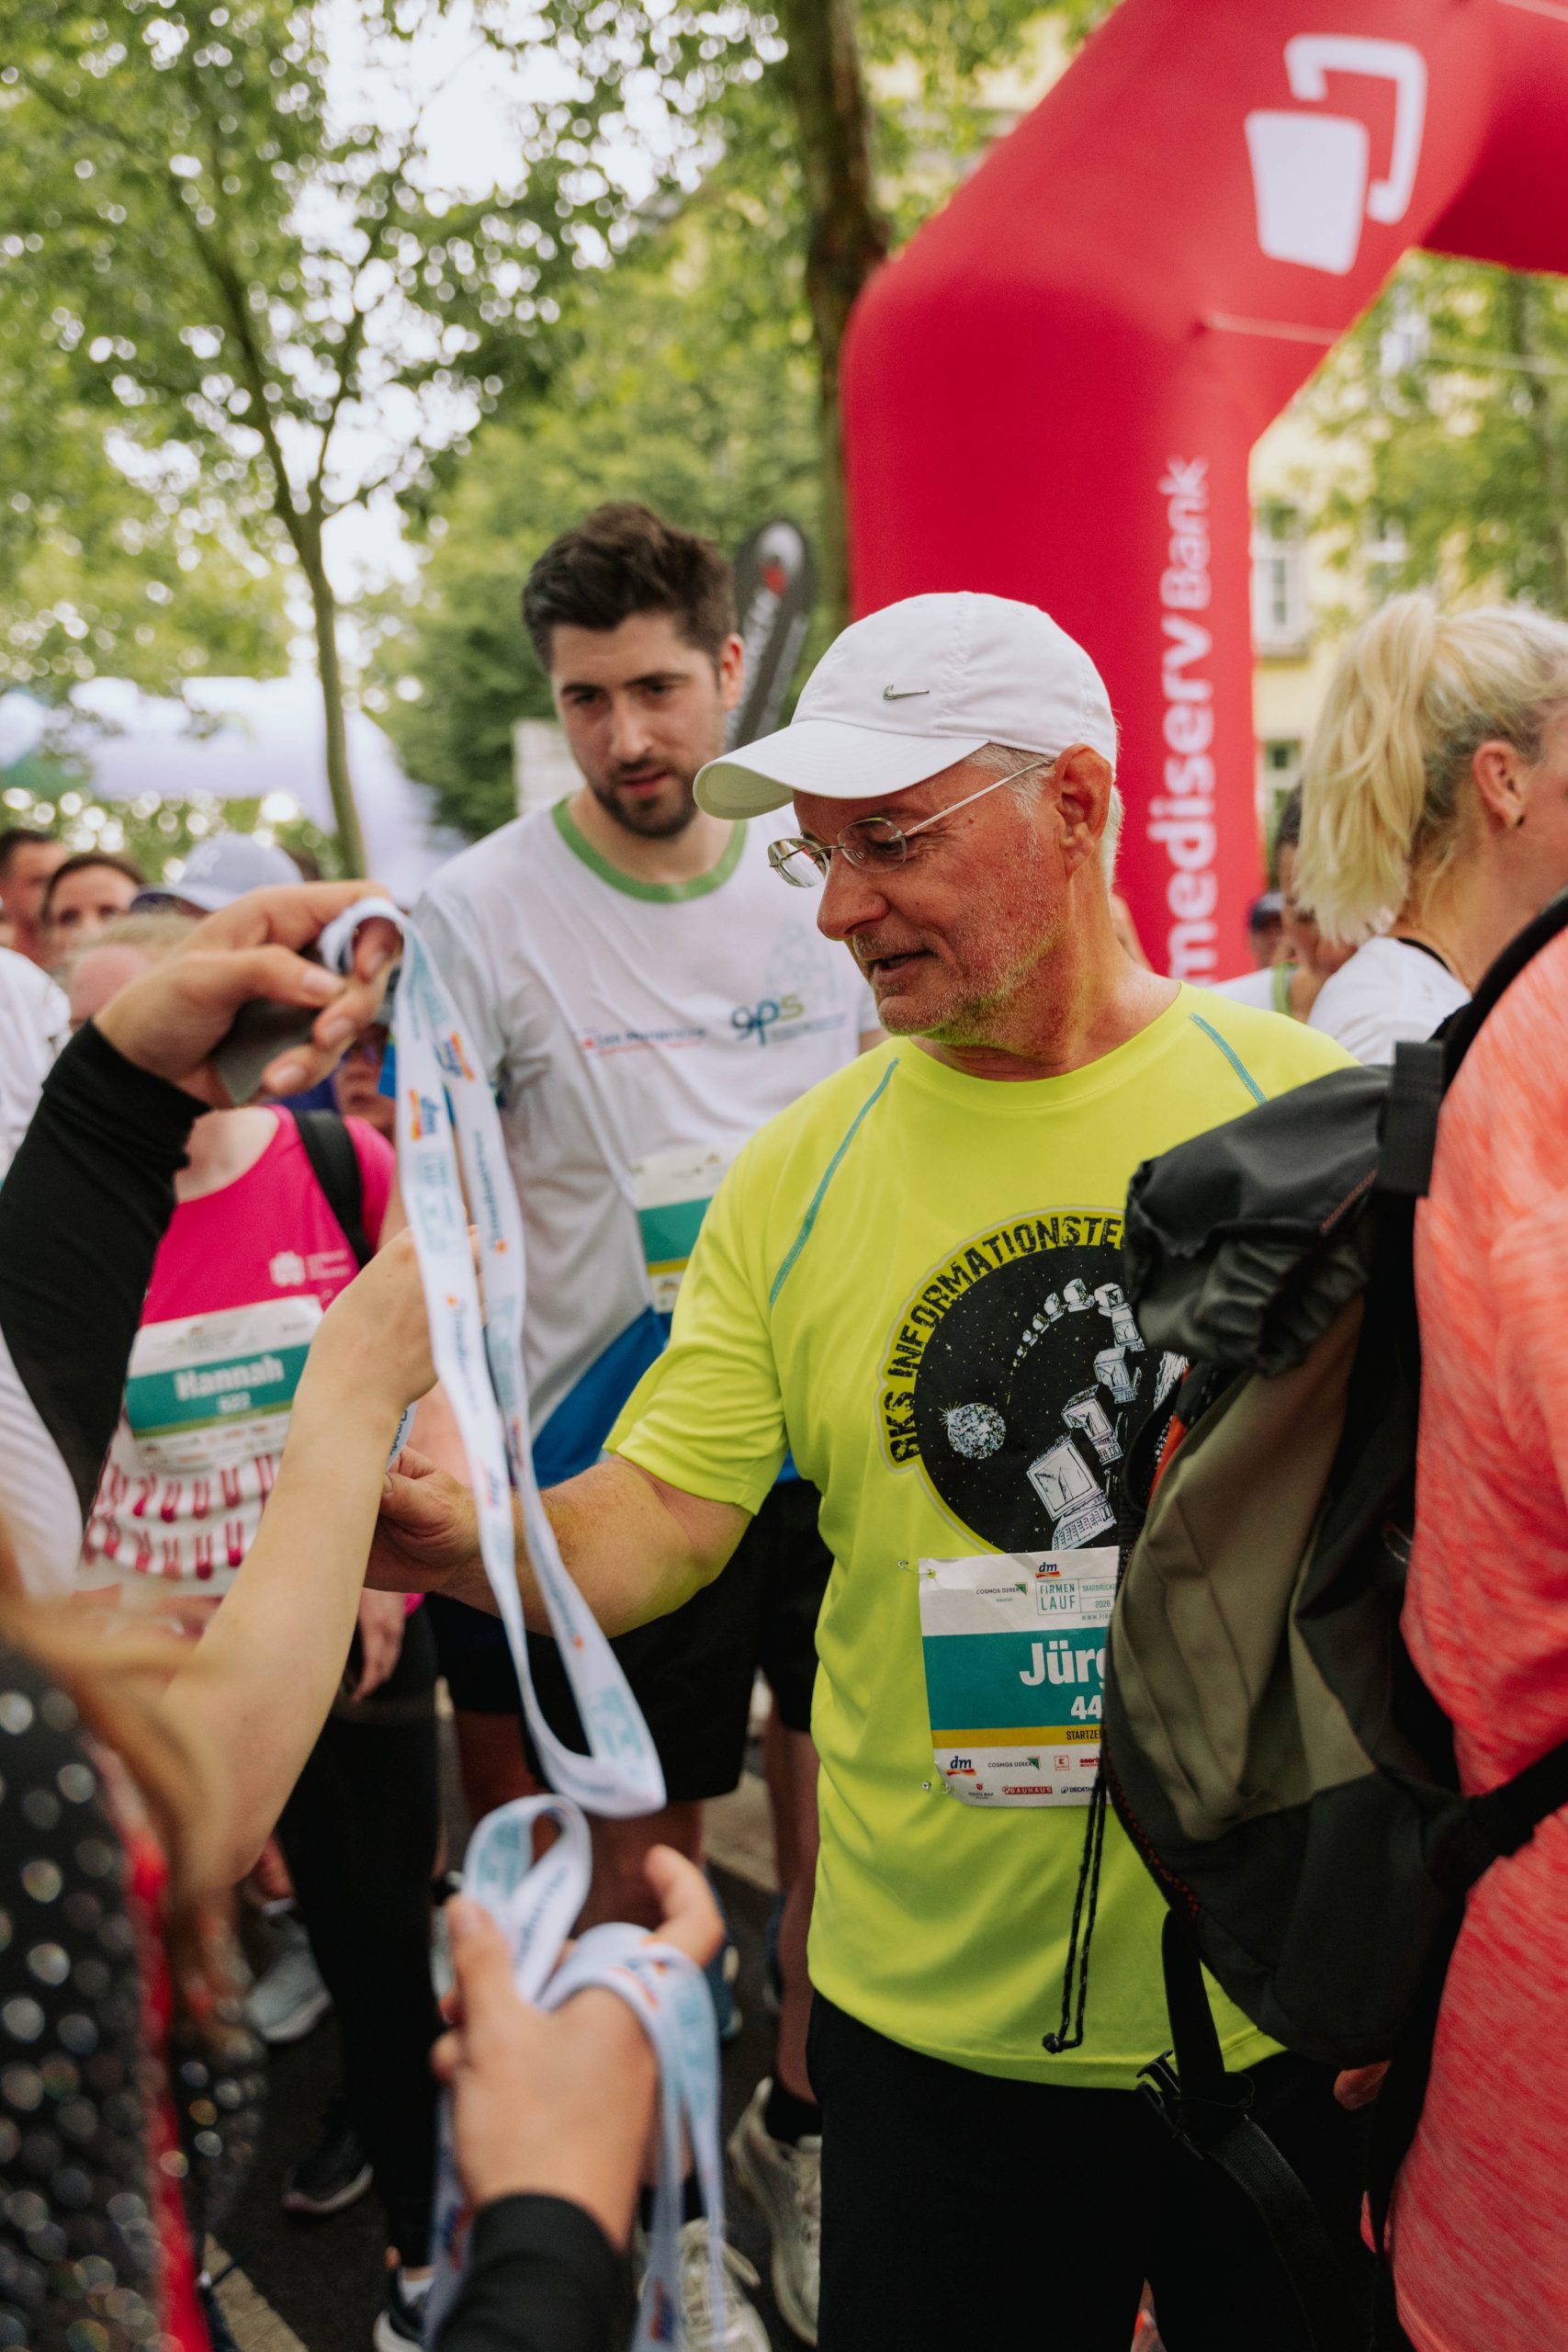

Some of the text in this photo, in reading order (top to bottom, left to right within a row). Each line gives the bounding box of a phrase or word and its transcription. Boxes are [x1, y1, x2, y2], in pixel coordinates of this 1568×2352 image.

[1148, 458, 1218, 987] mediserv Bank
[174, 1355, 285, 1401] Hannah
[1039, 1562, 1057, 1573] dm
[1040, 1583, 1075, 1594] FIRMEN
[1041, 1595, 1076, 1611] LAUF
[950, 1756, 972, 1770] dm
[1010, 1786, 1052, 1794] BAUHAUS
